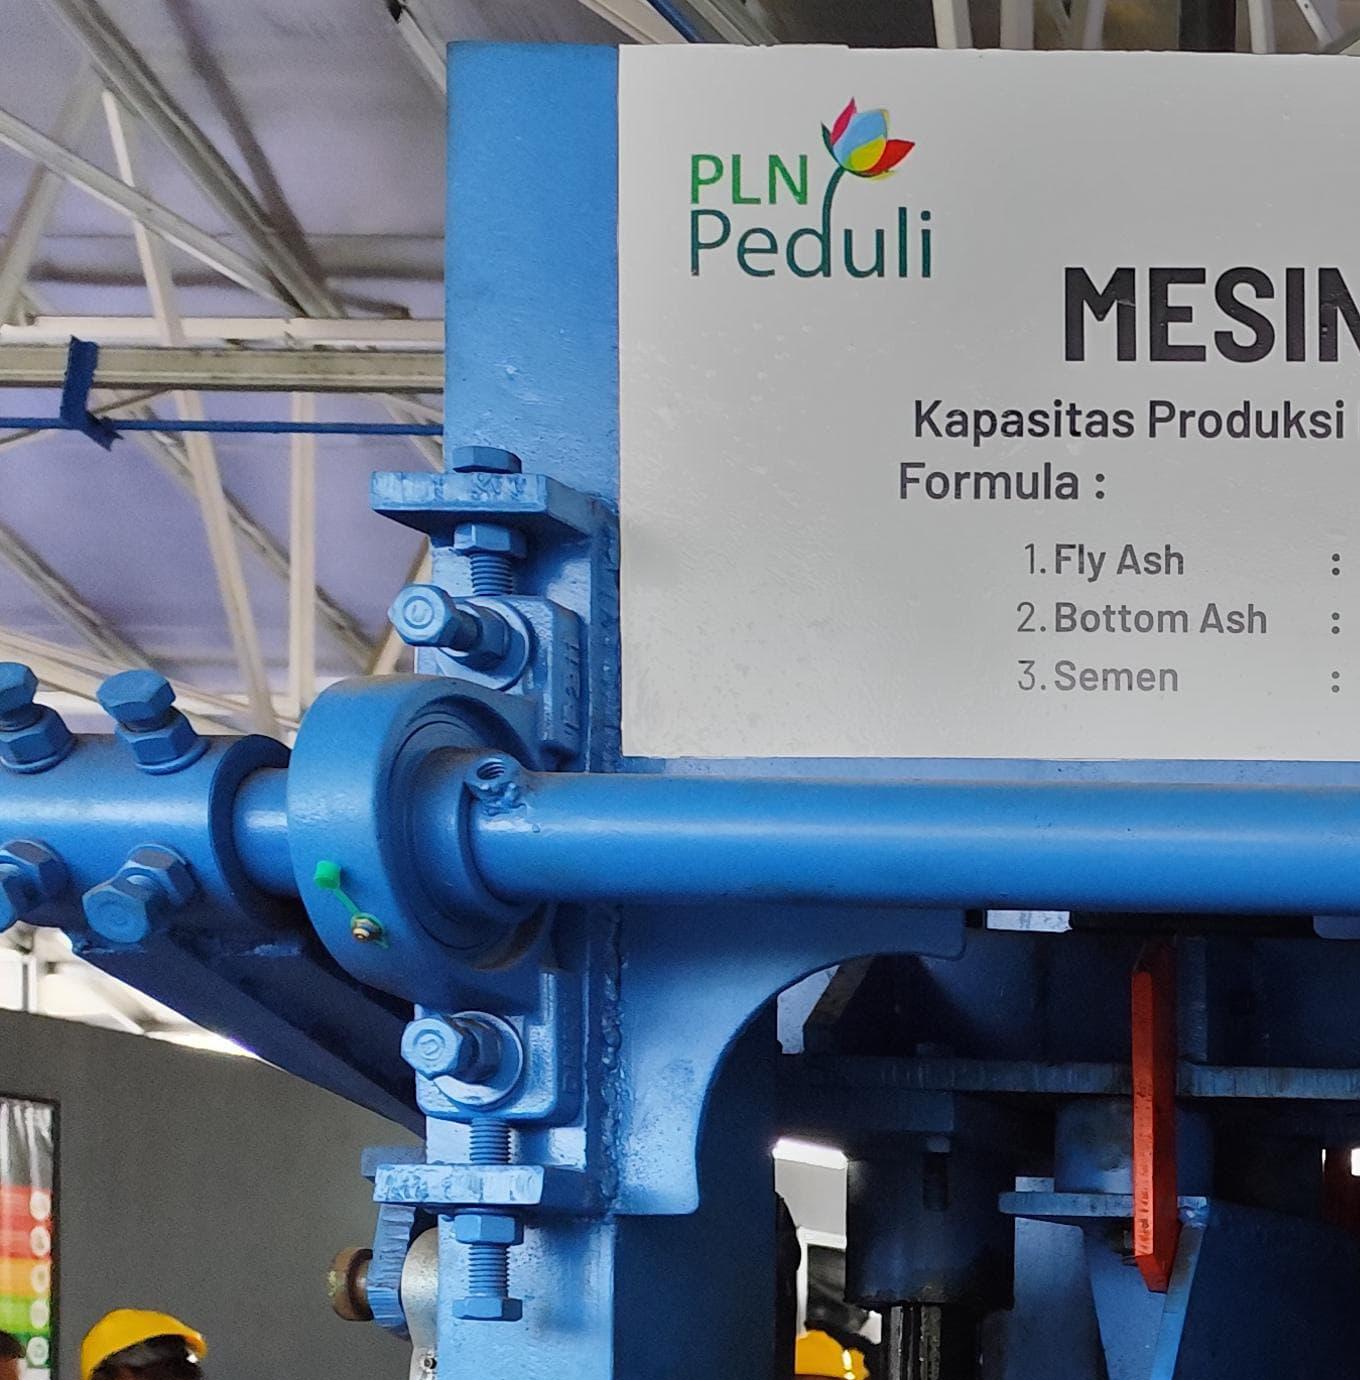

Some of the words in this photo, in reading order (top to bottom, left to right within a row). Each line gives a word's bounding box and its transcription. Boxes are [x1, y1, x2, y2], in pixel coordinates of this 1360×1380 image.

[690, 153, 809, 205] PLN
[690, 206, 932, 279] Peduli
[914, 398, 1135, 448] Kapasitas
[1148, 398, 1345, 440] Produksi
[899, 461, 1079, 501] Formula
[1024, 542, 1047, 575] 1.
[1055, 542, 1107, 584] Fly
[1116, 543, 1184, 576] Ash
[1016, 601, 1047, 633] 2.
[1055, 601, 1189, 634] Bottom
[1199, 602, 1267, 634] Ash
[1017, 659, 1047, 691] 3.
[1054, 659, 1178, 692] Semen
